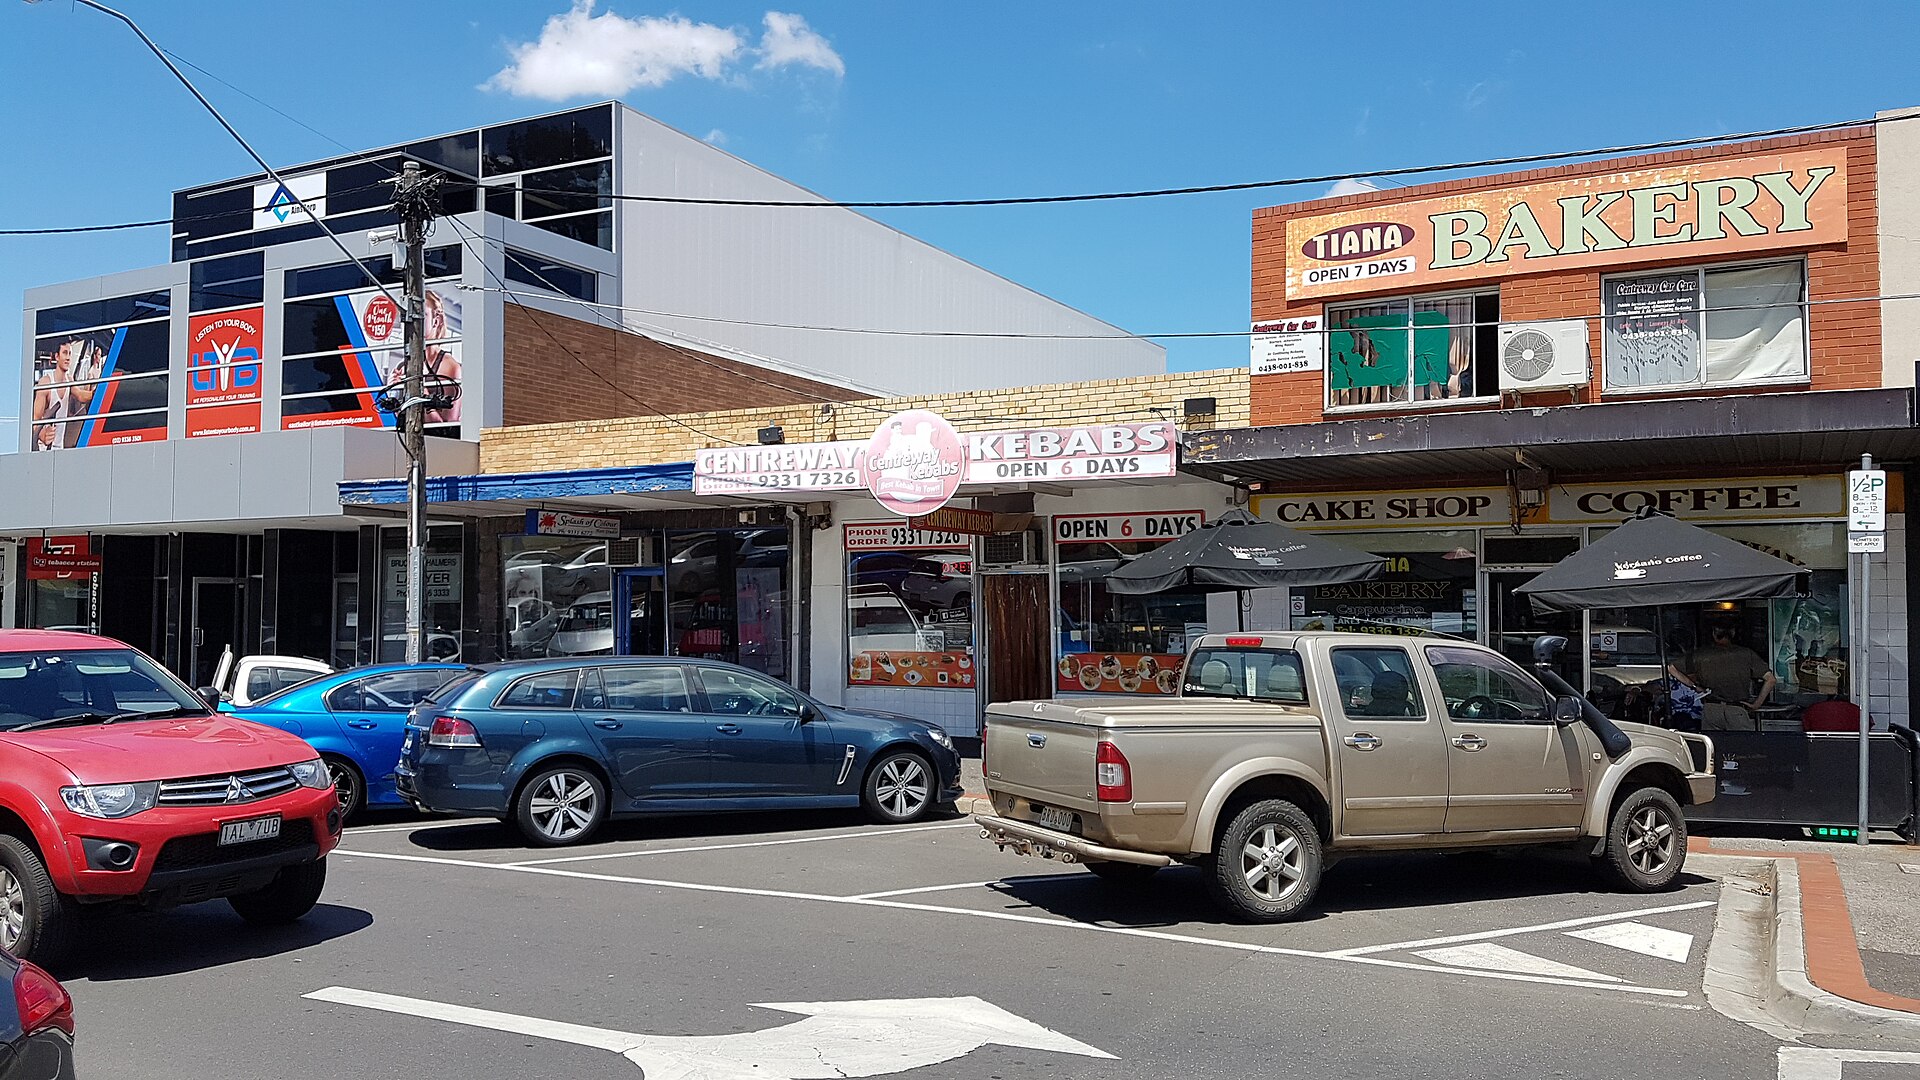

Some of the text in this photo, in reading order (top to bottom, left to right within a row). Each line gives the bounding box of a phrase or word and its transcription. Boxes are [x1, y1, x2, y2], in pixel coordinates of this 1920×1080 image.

[290, 203, 317, 215] Ainsorp
[1429, 165, 1835, 270] BAKERY
[1312, 224, 1404, 259] TIANA
[1309, 259, 1408, 283] OPEN 7 DAYS
[1617, 279, 1696, 296] Centreway Car Care
[194, 318, 257, 343] LISTEN TO YOUR BODY
[968, 423, 1169, 462] KEBABS
[698, 447, 860, 475] CENTREWAY
[869, 447, 941, 472] Centreway
[996, 457, 1139, 478] OPEN 6 DAYS
[910, 459, 960, 480] Kebabs
[758, 471, 856, 488] 9331 7326
[923, 484, 941, 493] Town
[1277, 496, 1491, 522] CAKE SHOP
[1577, 485, 1800, 514] COFFEE
[926, 509, 993, 533] CENTREWAY KEBABS
[1059, 516, 1197, 539] OPEN 6 DAYS
[848, 528, 888, 536] PHONE
[891, 527, 923, 546] 9331
[848, 538, 888, 546] ORDER
[1280, 544, 1307, 554] Coffee
[48, 558, 75, 567] tobacco
[425, 558, 457, 567] HALMERS
[1664, 553, 1703, 564] Coffee
[396, 573, 450, 584] LAYER
[1314, 581, 1451, 600] BAKERY
[1336, 604, 1425, 616] Cappuccino
[256, 818, 279, 836] 7UB
